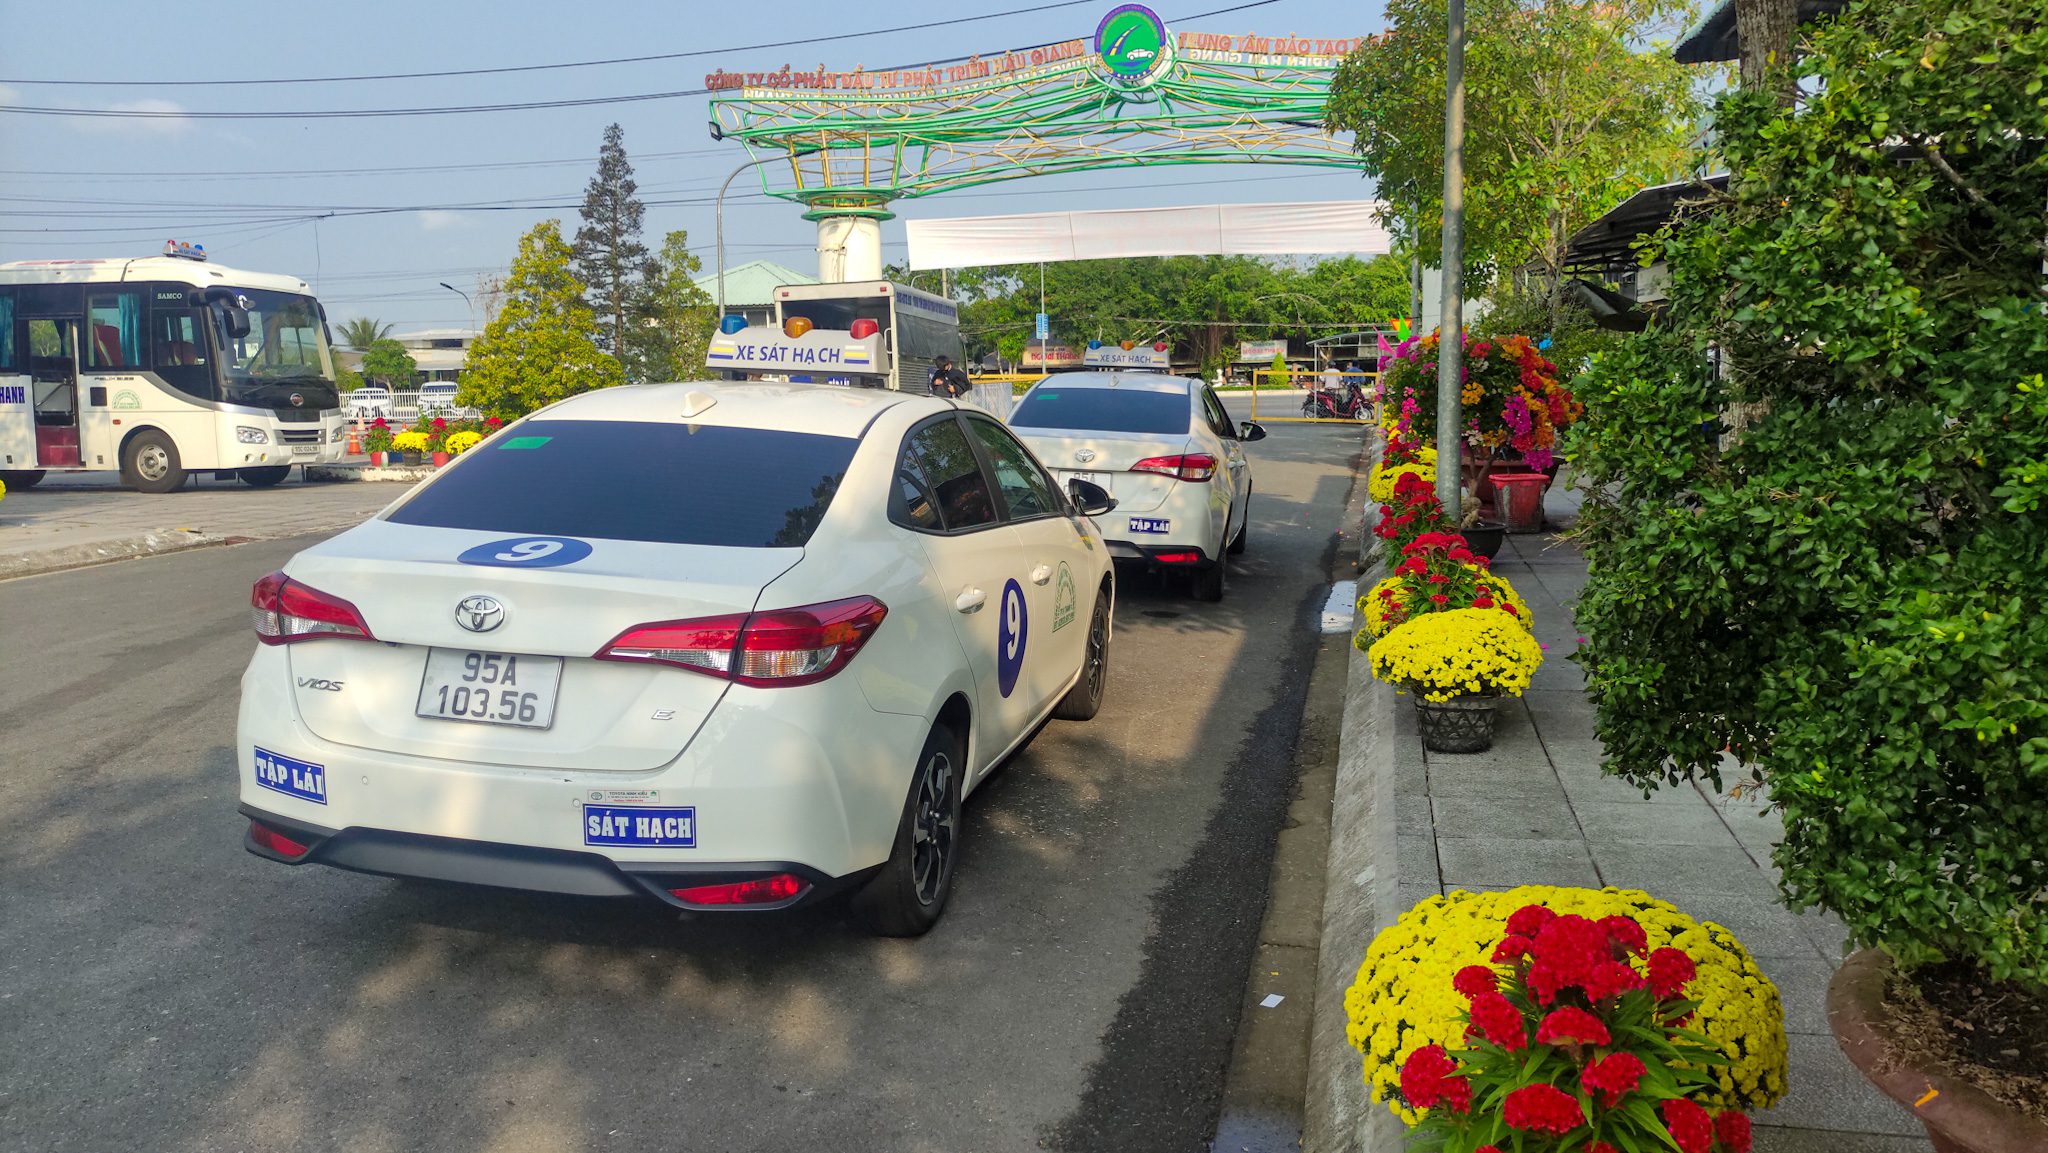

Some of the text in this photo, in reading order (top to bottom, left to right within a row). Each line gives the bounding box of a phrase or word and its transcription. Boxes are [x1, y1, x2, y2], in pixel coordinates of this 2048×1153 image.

[747, 73, 764, 89] TY
[1030, 39, 1084, 66] GIANG
[157, 292, 183, 300] SAMCO
[736, 342, 841, 365] XE SÁT HẠCH
[1100, 354, 1110, 363] XE
[1130, 518, 1170, 532] TẬP LÁI
[495, 540, 563, 562] 9
[1007, 589, 1021, 661] 9
[462, 652, 516, 686] 95A
[297, 676, 345, 692] VIOS
[438, 685, 538, 723] 103.56
[651, 709, 676, 720] E
[256, 756, 324, 795] TẬP LÁI
[588, 810, 692, 844] SÁT HẠCH
